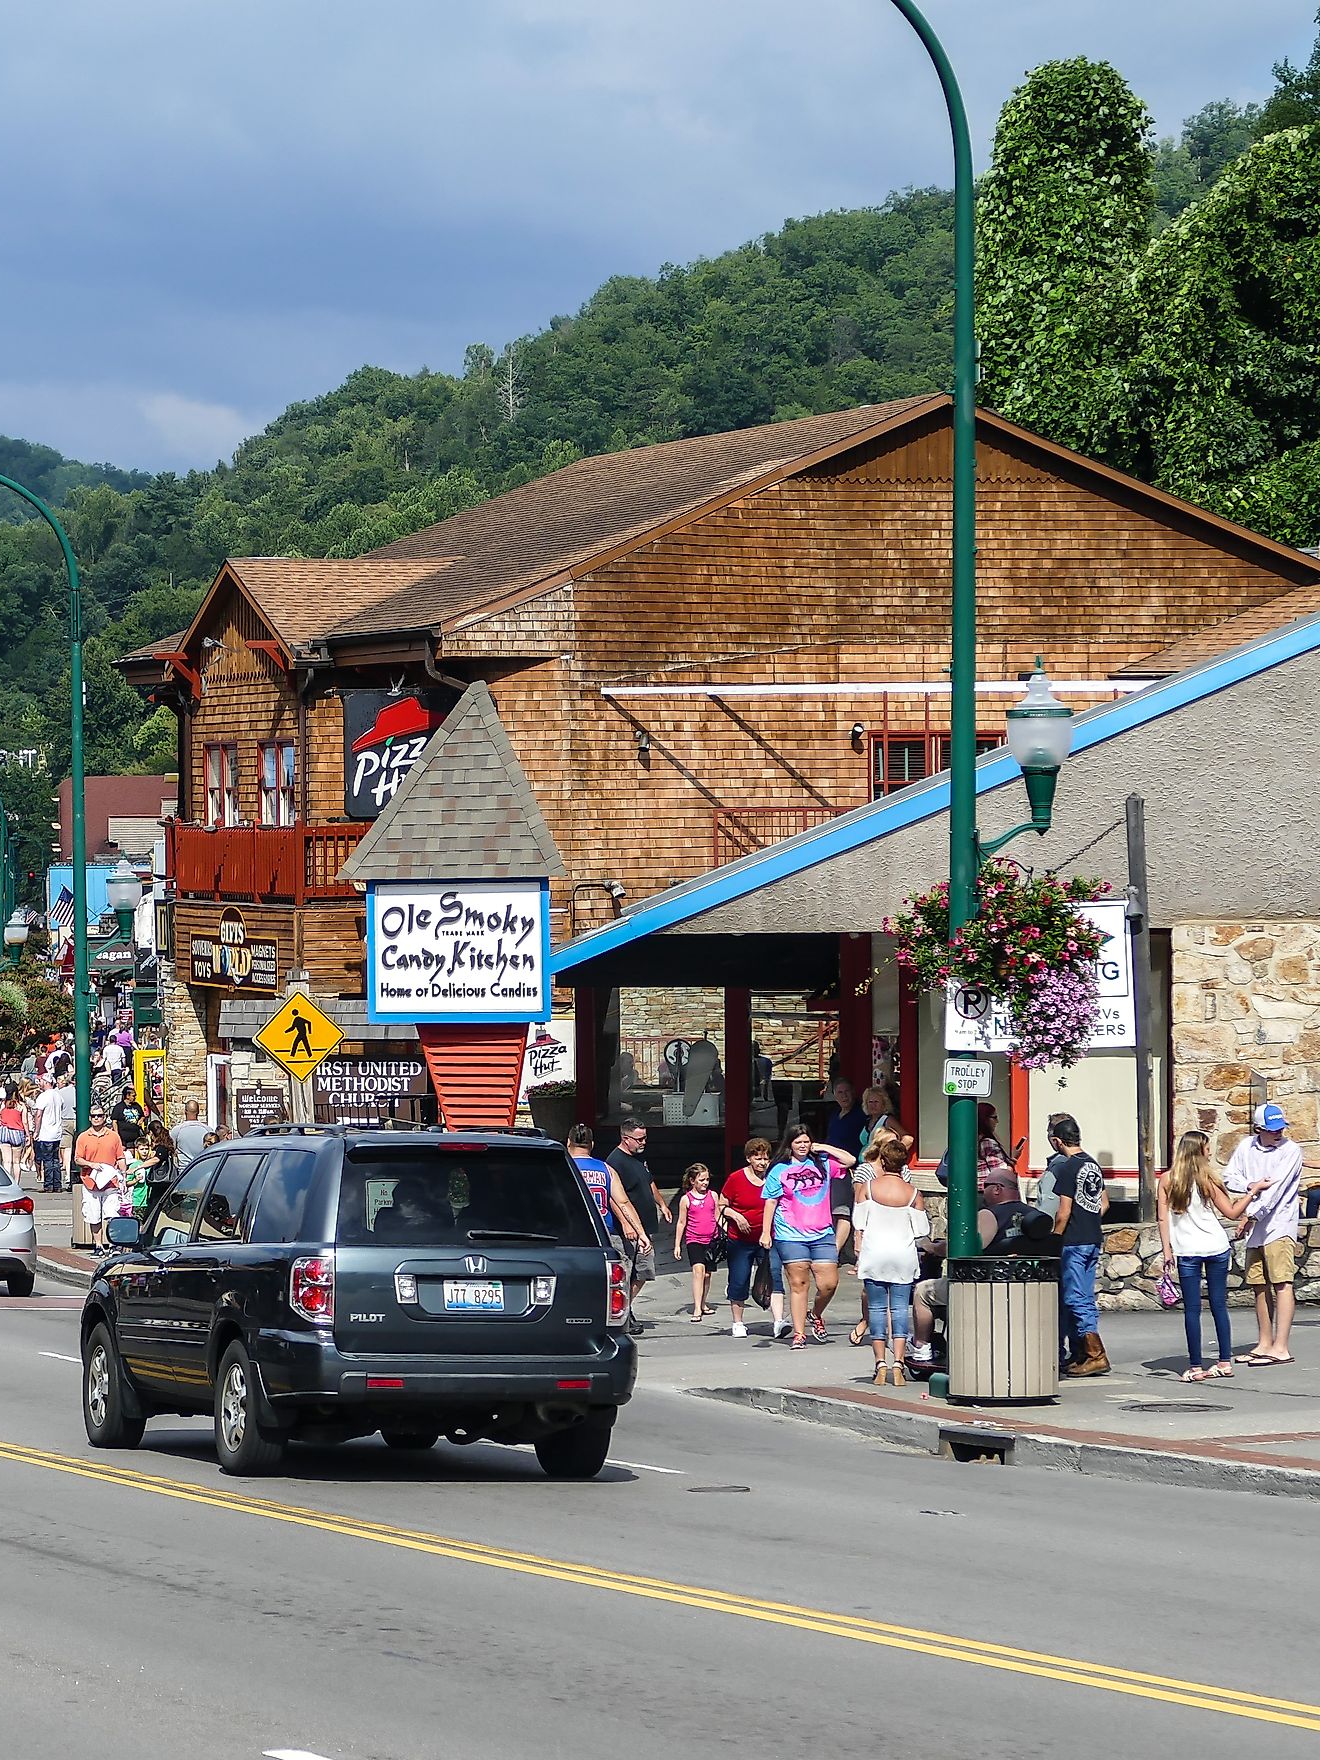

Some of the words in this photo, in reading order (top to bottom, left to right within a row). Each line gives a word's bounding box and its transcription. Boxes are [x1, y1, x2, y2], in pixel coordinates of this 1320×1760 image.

[353, 736, 427, 797] Pizz
[381, 903, 433, 940] Ole
[435, 891, 535, 950] Smoky
[250, 944, 276, 958] MAGNETS
[194, 960, 212, 978] TOYS
[381, 944, 447, 985] Candy
[447, 938, 535, 984] Kitchen
[381, 982, 412, 998] Home
[431, 982, 486, 998] Delicious
[490, 982, 538, 998] Candies
[528, 1046, 567, 1066] Pizza
[316, 1062, 353, 1076] IRST
[358, 1062, 423, 1076] UNITED
[533, 1059, 561, 1077] Hut
[950, 1066, 986, 1078] TROLLEY
[317, 1077, 411, 1092] METHODIST
[957, 1079, 978, 1089] STOP
[329, 1092, 400, 1107] CHURCH
[447, 1288, 467, 1304] J77
[474, 1288, 502, 1305] 8295
[349, 1312, 386, 1323] PILOT
